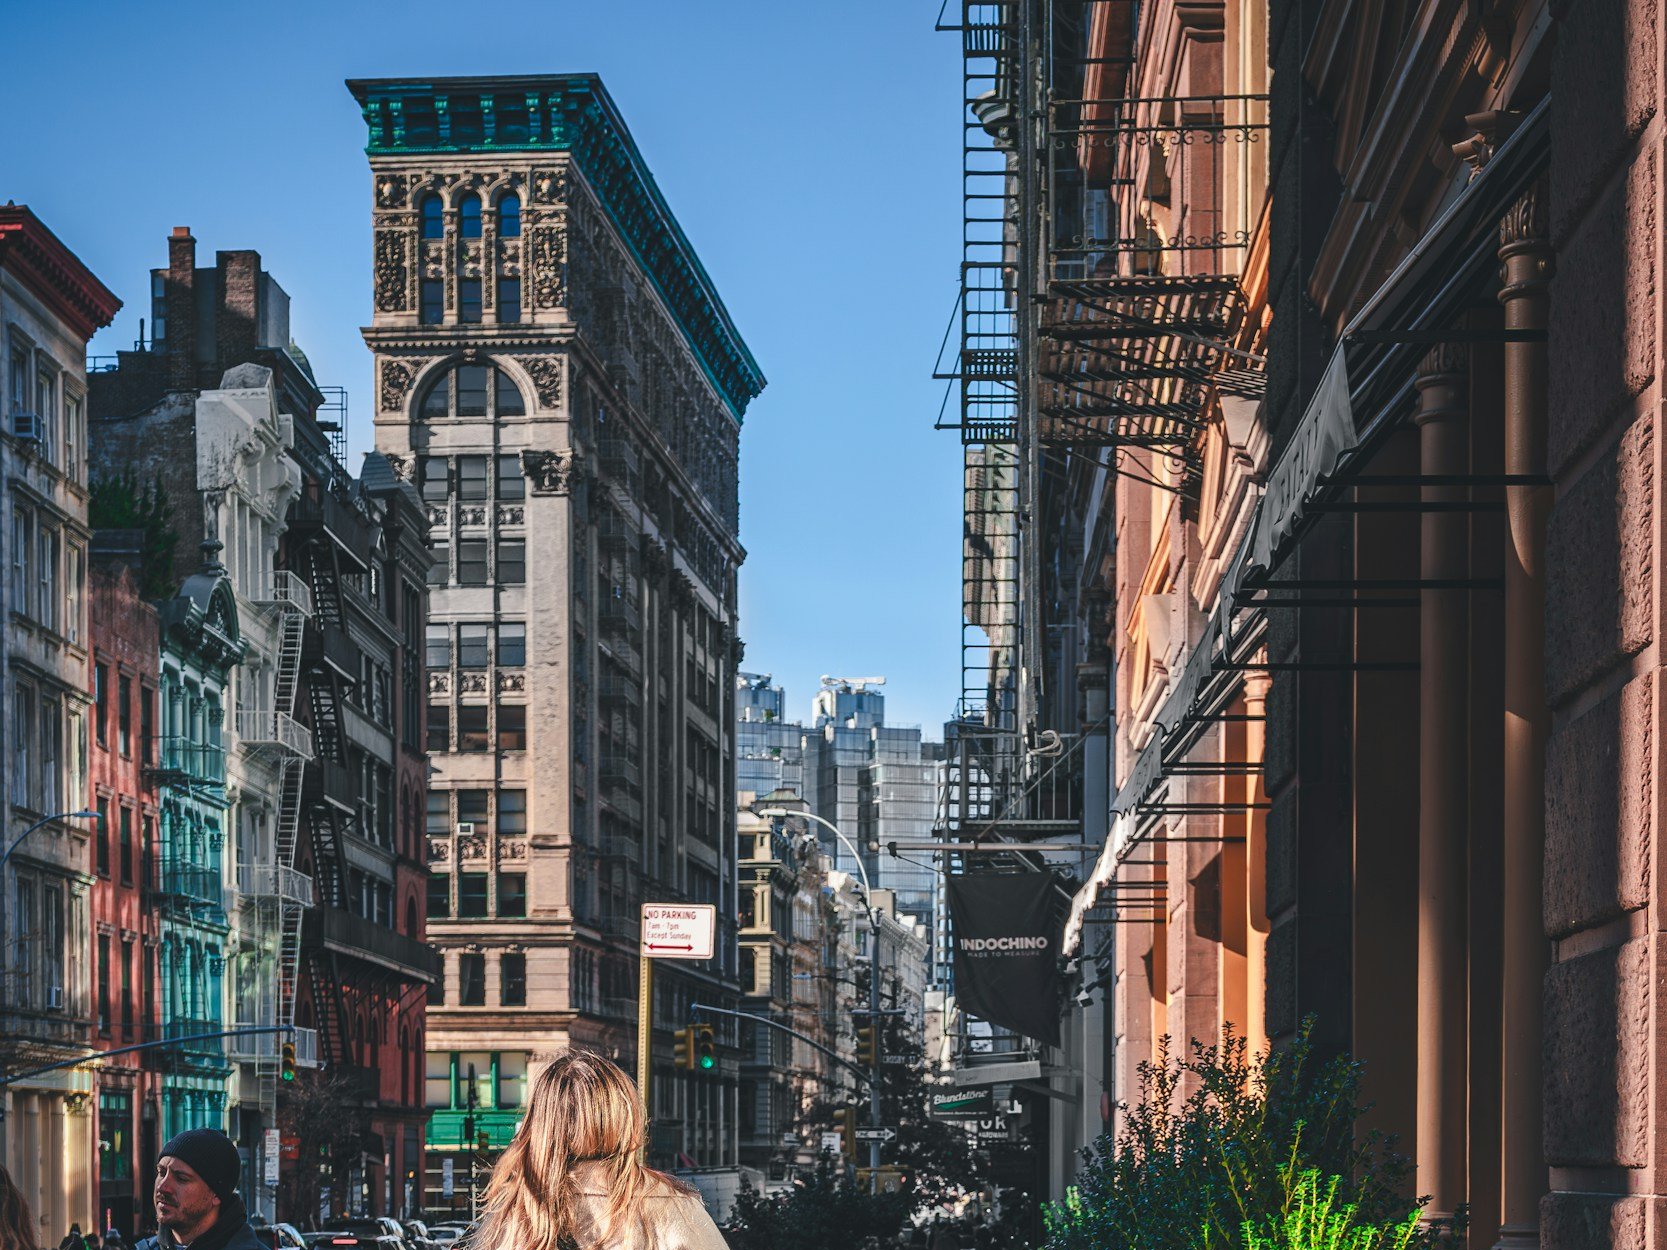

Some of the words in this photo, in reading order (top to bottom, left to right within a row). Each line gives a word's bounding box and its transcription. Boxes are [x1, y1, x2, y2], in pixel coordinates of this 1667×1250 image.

[648, 910, 659, 919] NO
[661, 910, 697, 920] PARKING
[647, 931, 668, 940] Except
[669, 932, 691, 940] Sunday
[960, 936, 1048, 951] INDOCHINO
[933, 1090, 989, 1105] Blundstone
